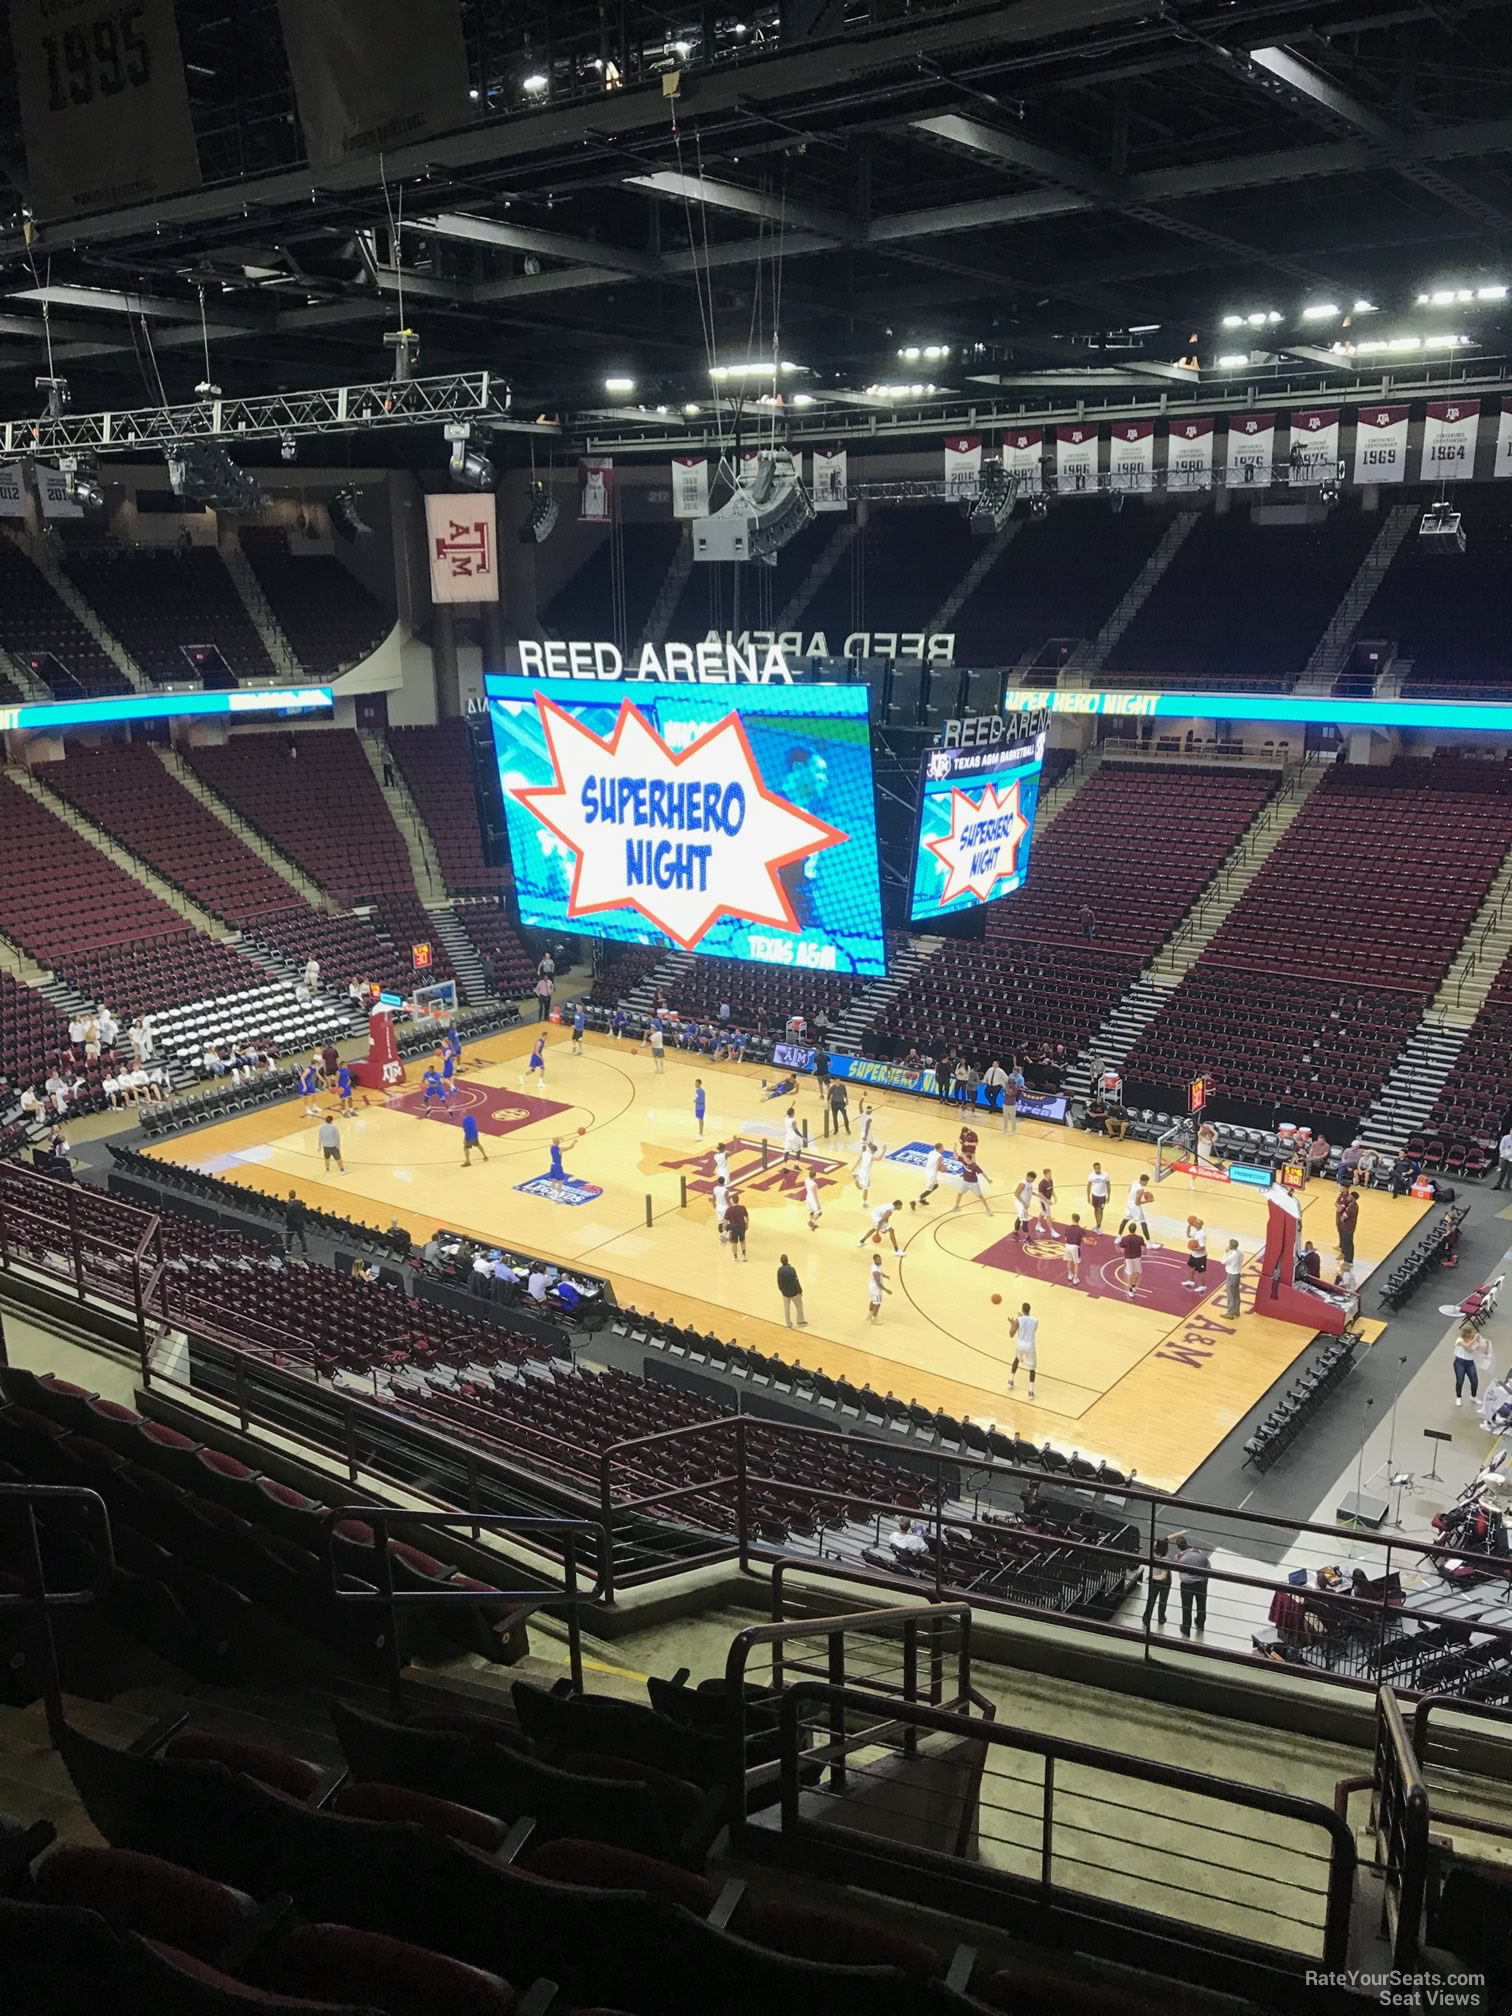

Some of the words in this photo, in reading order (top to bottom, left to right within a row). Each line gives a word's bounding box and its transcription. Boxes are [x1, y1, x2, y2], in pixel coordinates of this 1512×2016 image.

[41, 6, 151, 112] 1995
[1175, 460, 1204, 473] 1980
[1300, 452, 1329, 465] 975
[1363, 450, 1396, 465] 1969
[1430, 445, 1466, 461] 1964
[1117, 462, 1144, 474] 1980
[48, 488, 70, 501] 201
[518, 640, 623, 682] REED
[636, 642, 794, 684] ARENA
[1104, 694, 1161, 716] NIGHT
[944, 716, 1003, 748] REED
[1005, 706, 1051, 741] ARENA
[954, 756, 980, 771] TEXAS
[1000, 744, 1035, 762] BASKETBALL
[581, 775, 746, 837] SUPERHERO
[960, 812, 1014, 851] SUPERHERO
[626, 838, 713, 892] NIGHT
[969, 846, 1001, 878] NIGHT
[748, 935, 793, 965] TEXAS
[1288, 1175, 1299, 1184] 30
